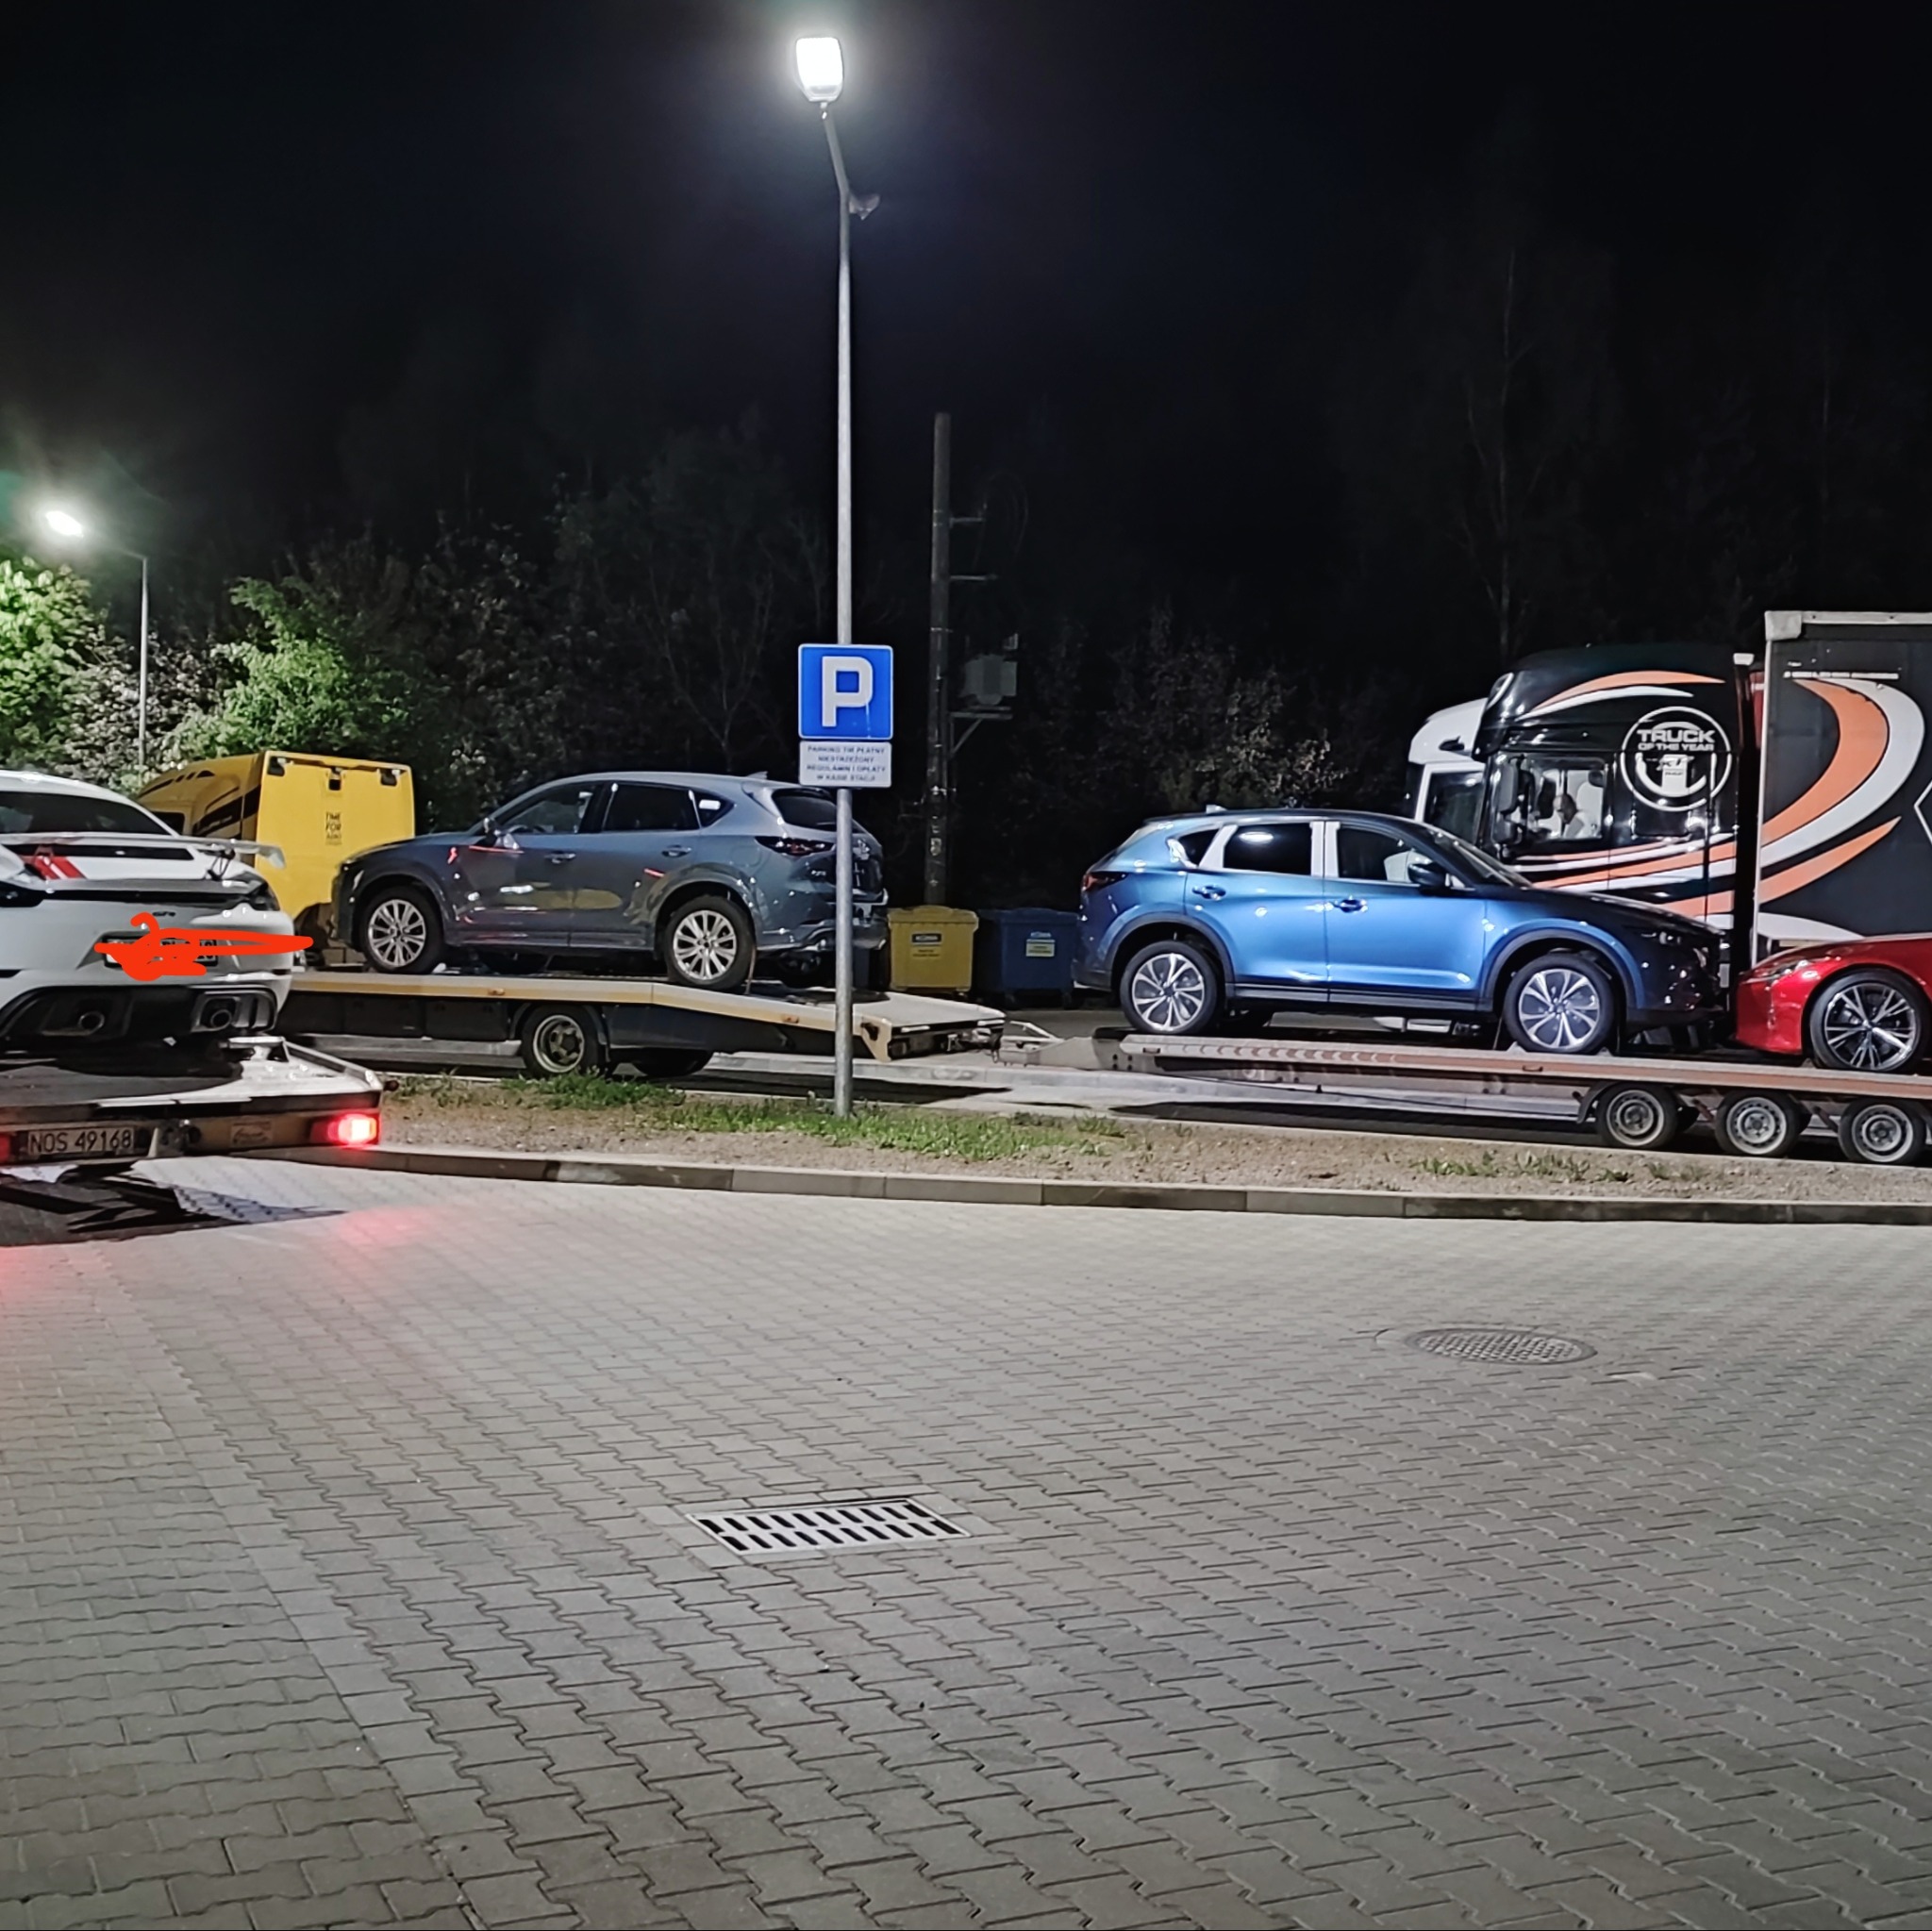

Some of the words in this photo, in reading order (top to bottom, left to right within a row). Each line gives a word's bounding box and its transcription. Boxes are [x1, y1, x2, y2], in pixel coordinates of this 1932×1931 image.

[822, 656, 874, 727] P
[1636, 729, 1716, 743] TRUCK
[808, 745, 841, 754] PARKING
[1638, 742, 1655, 751] OF
[1656, 742, 1679, 751] THE
[1681, 743, 1714, 752] YEAR
[325, 822, 341, 831] FOR
[30, 1132, 68, 1153] NOS
[74, 1129, 132, 1152] 49168
